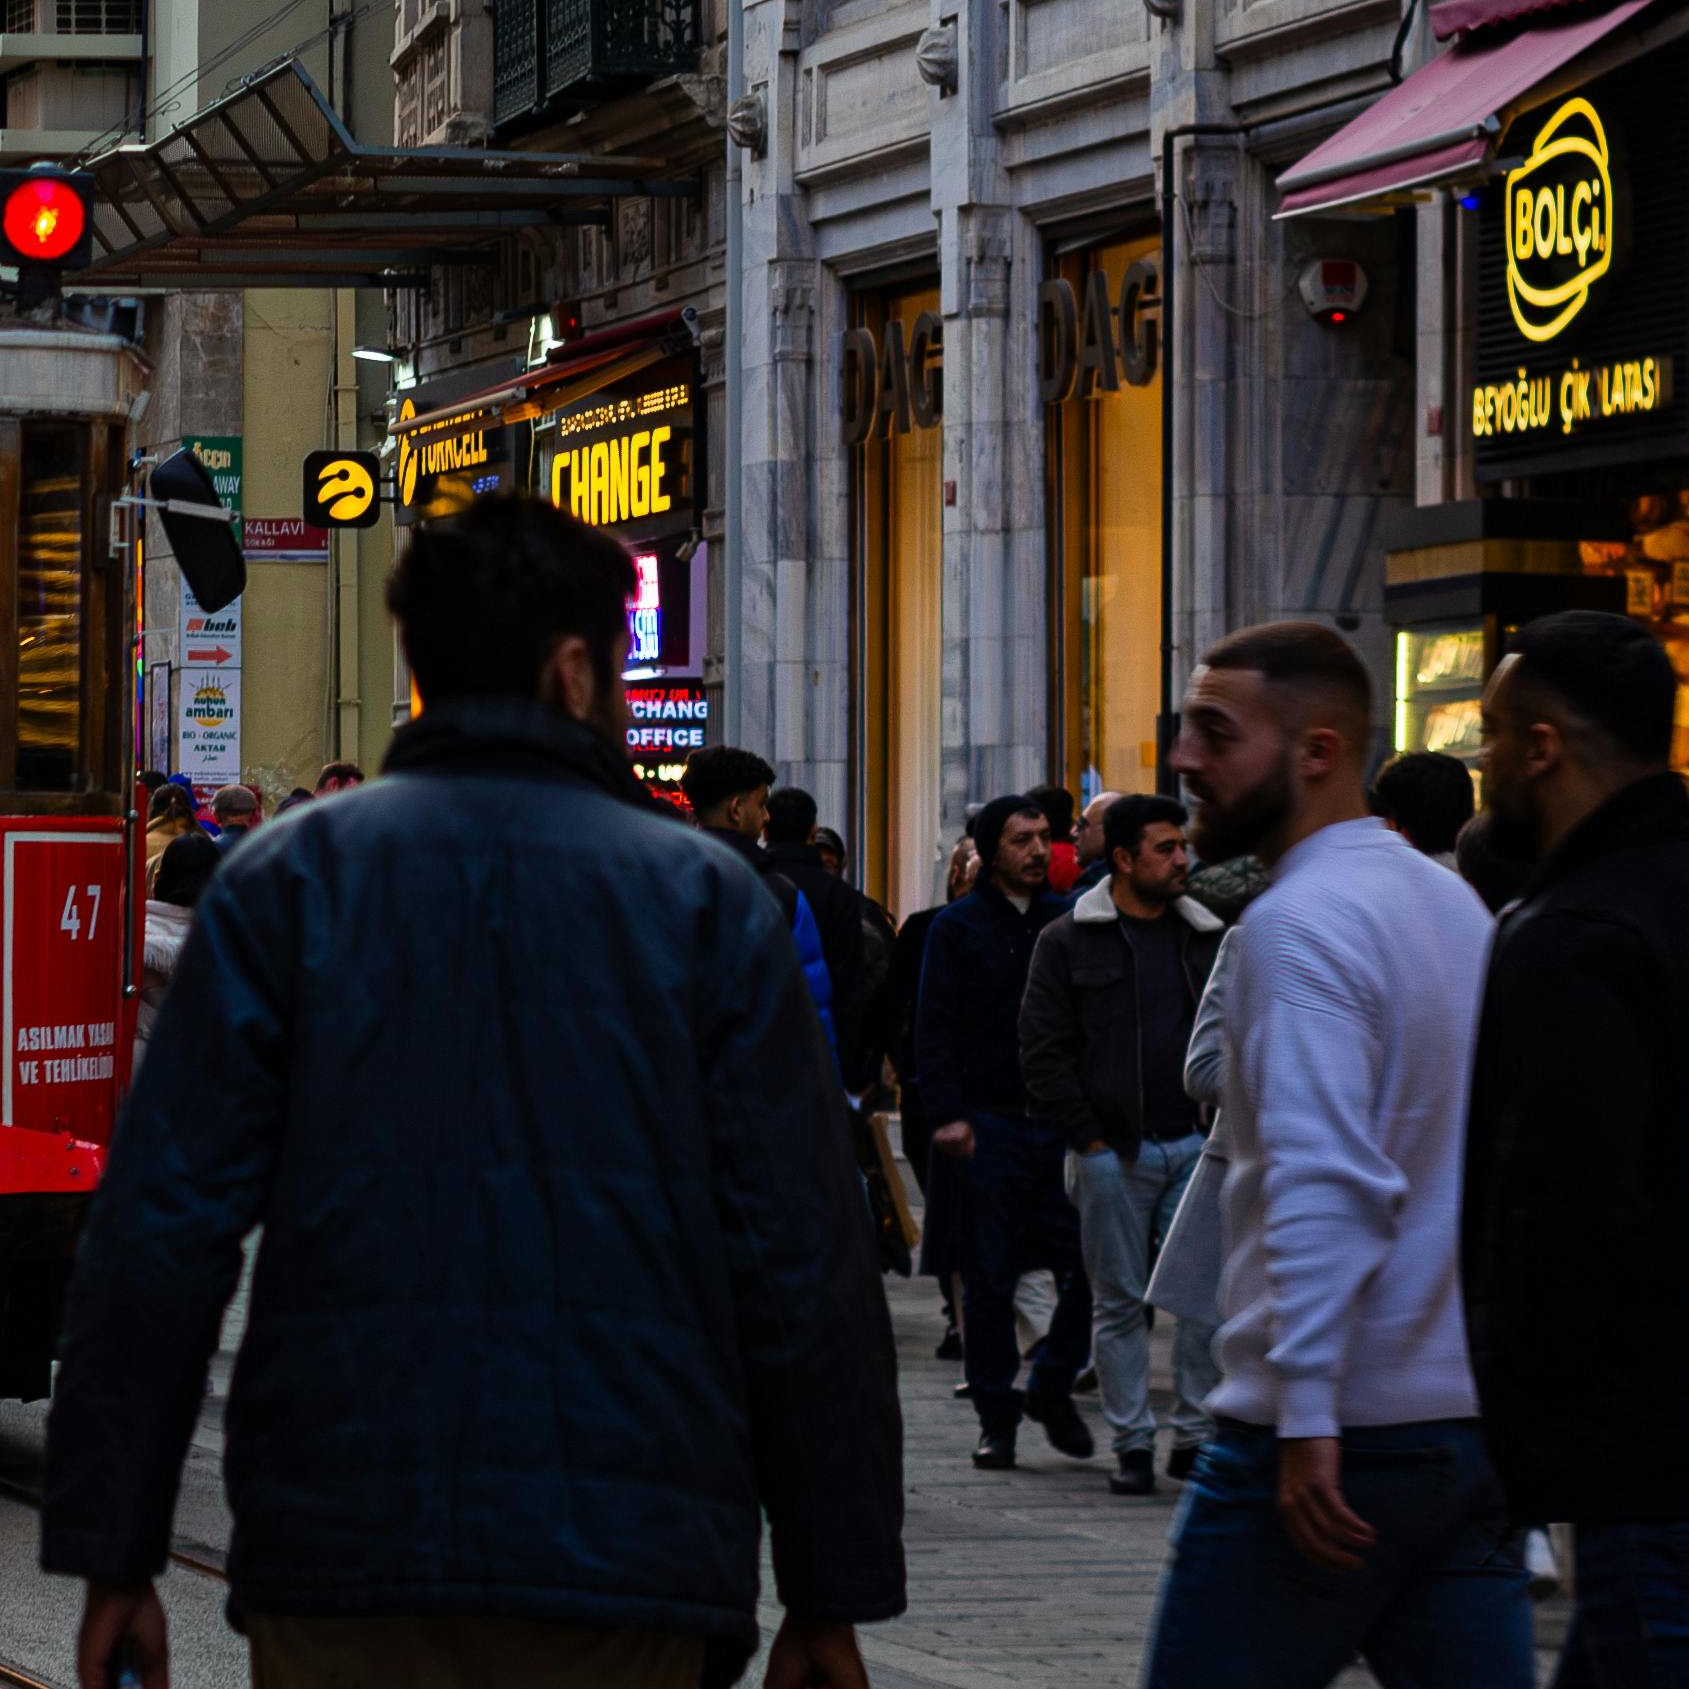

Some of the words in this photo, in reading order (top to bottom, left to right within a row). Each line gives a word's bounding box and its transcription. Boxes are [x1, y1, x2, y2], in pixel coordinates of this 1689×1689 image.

[1473, 366, 1551, 437] BEYOĞLU
[551, 425, 671, 526] CHANGE
[626, 728, 703, 747] OFFICE
[60, 884, 102, 941] 47
[17, 1024, 86, 1052] ASILMAK
[19, 1060, 40, 1086] VE
